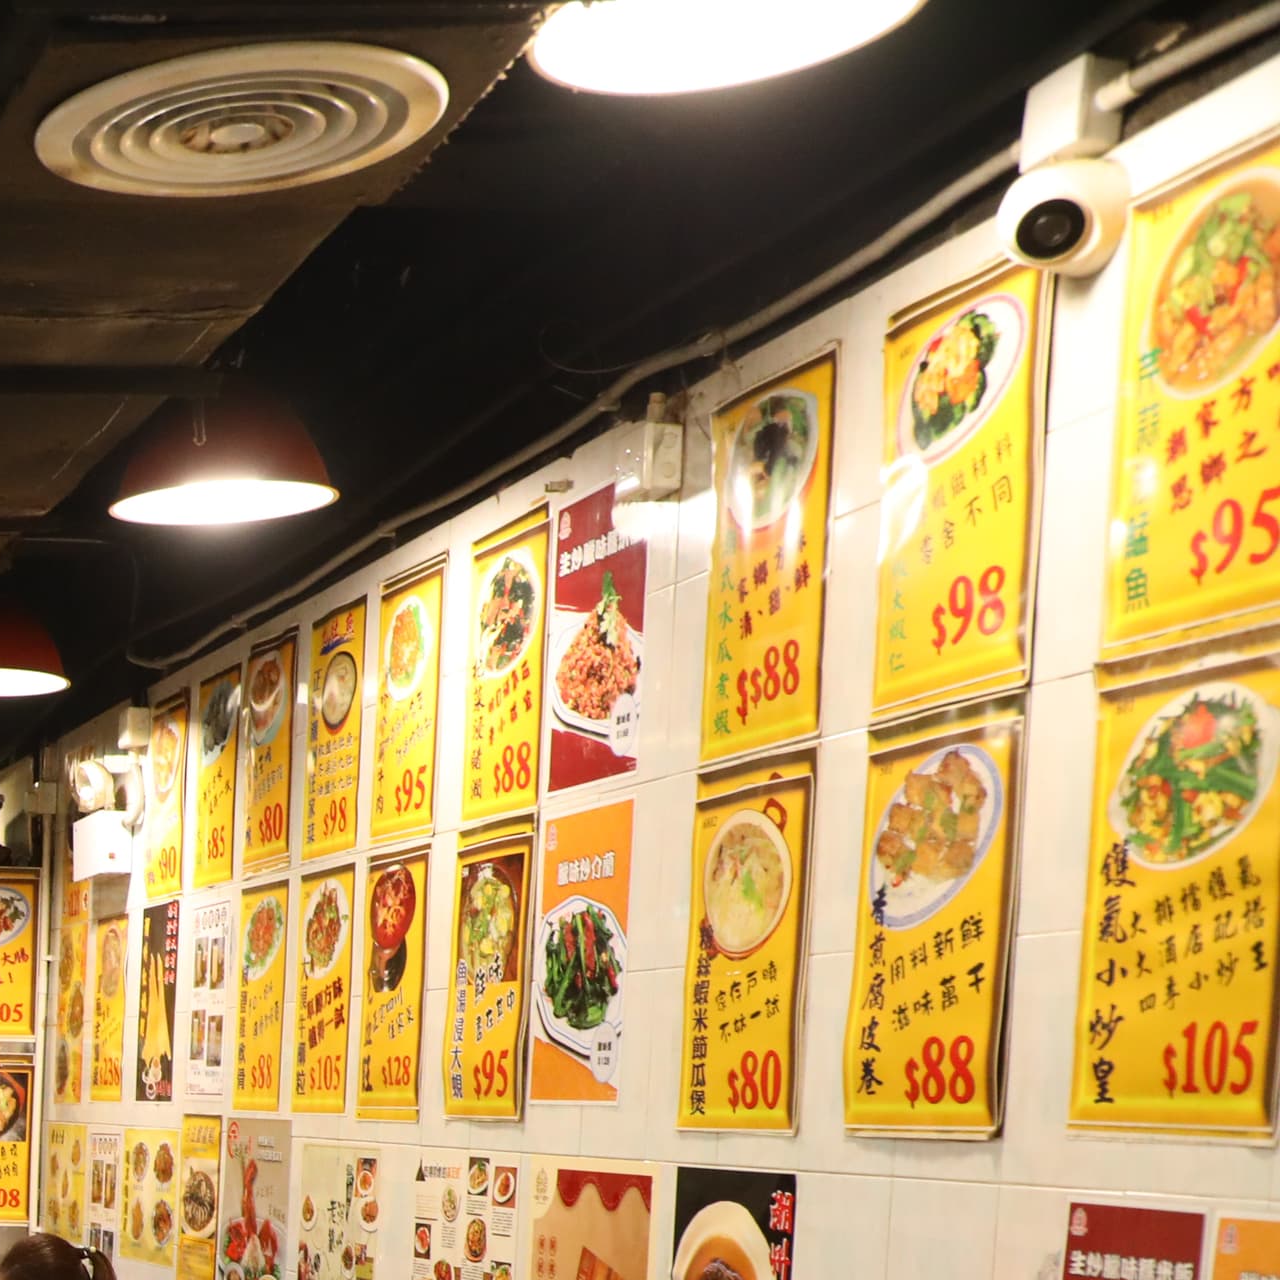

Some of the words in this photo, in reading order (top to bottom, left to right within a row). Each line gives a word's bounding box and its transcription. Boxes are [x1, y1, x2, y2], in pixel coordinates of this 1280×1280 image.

[1190, 486, 1280, 585] $95
[932, 566, 1005, 655] $98
[395, 766, 426, 816] $95
[494, 741, 531, 797] $88
[208, 826, 225, 859] $85
[259, 802, 283, 846] $80
[323, 797, 347, 836] $98
[890, 913, 984, 985] 用料新鮮
[892, 962, 986, 1032] 滋味萬千
[252, 1054, 272, 1091] $88
[310, 1055, 340, 1090] $105
[383, 1055, 411, 1086] $128
[473, 1049, 509, 1100] $95
[728, 1050, 781, 1113] $80
[905, 1034, 975, 1109] $88
[1162, 1019, 1259, 1097] $105
